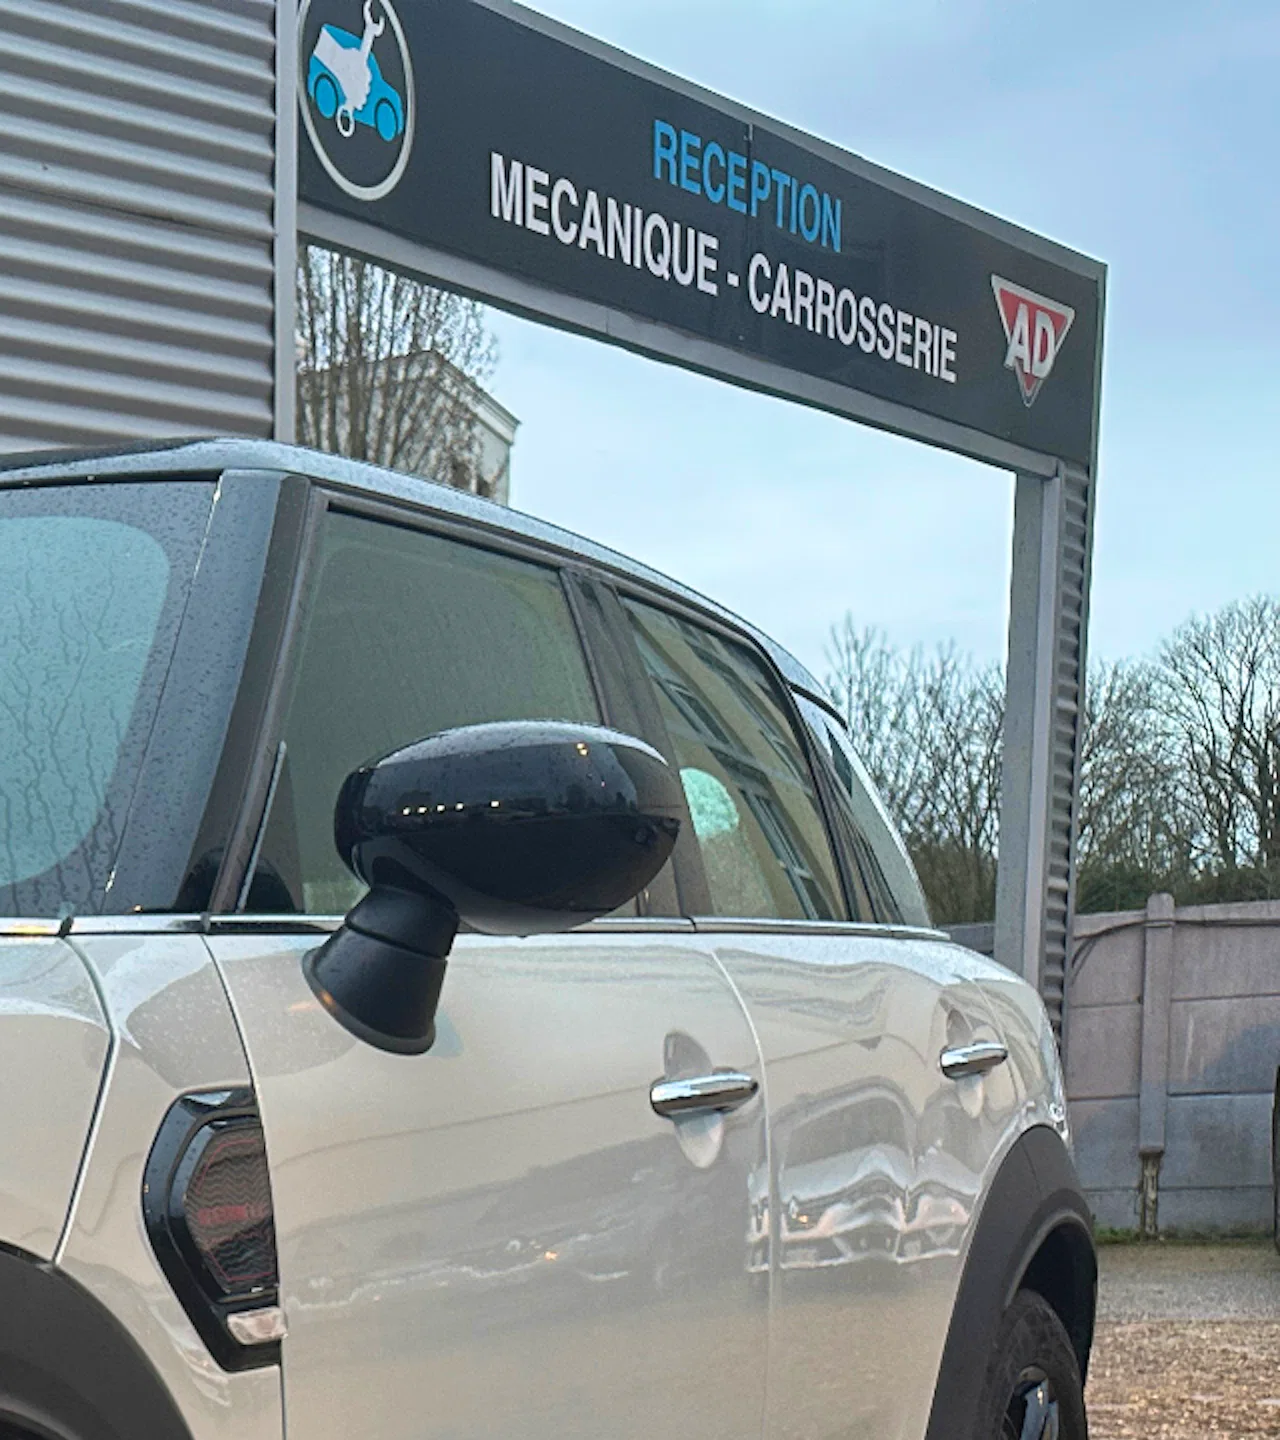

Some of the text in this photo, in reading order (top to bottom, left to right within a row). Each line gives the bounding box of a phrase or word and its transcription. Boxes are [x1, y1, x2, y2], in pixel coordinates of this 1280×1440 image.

[653, 119, 842, 254] RECEPTION
[490, 151, 959, 384] MECANIQUE - CARROSSERIE
[1003, 302, 1057, 379] AD
